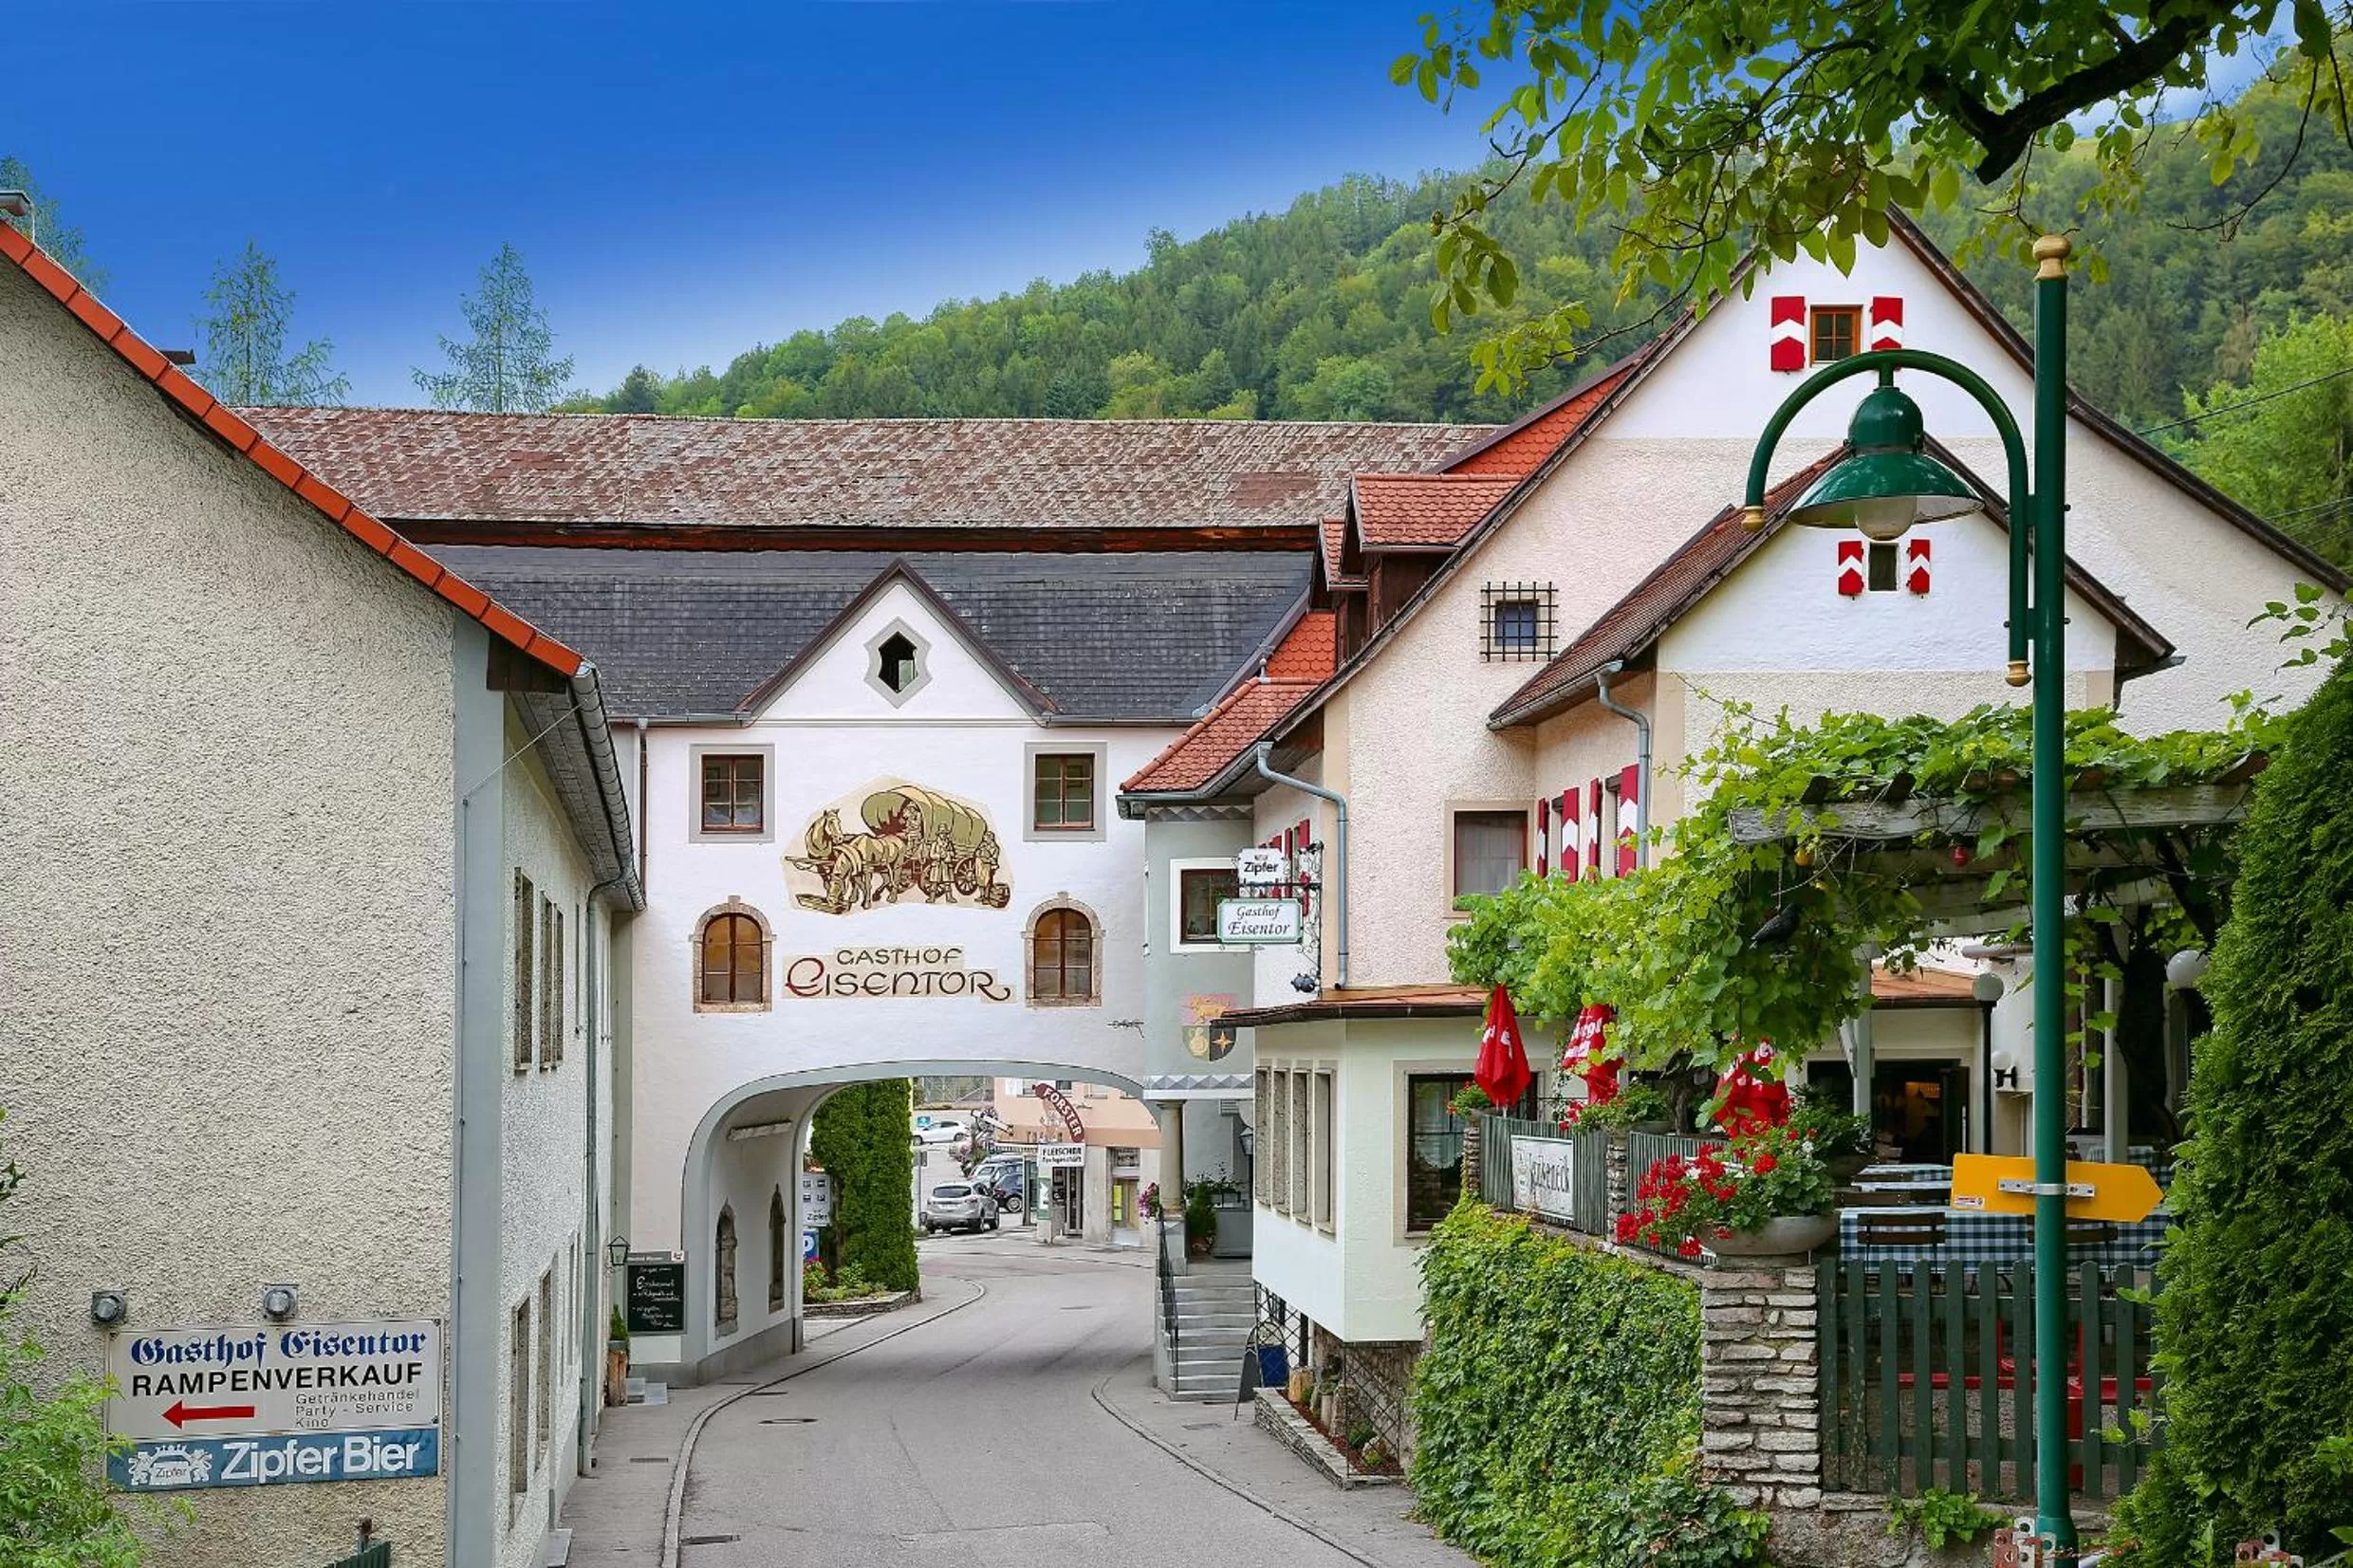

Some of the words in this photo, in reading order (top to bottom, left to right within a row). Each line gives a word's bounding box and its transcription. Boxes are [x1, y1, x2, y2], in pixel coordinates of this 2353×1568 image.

[1244, 861, 1279, 876] Zipfer
[1237, 905, 1281, 920] Gasthof
[1228, 921, 1290, 935] Eisentor
[837, 949, 962, 965] GASTHOF
[1044, 1087, 1082, 1136] FORSTER
[1043, 1147, 1082, 1156] FLEISCHER
[131, 1333, 268, 1369] Gasthof
[281, 1329, 427, 1358] Eisentor
[133, 1362, 423, 1396] RAMPENVERKAUF
[296, 1388, 419, 1404] Getränkehandel
[296, 1404, 336, 1418] Party
[355, 1402, 414, 1413] Service
[295, 1417, 329, 1428] Kino
[221, 1440, 338, 1484] Zipfer
[343, 1435, 419, 1473] Bier
[155, 1466, 188, 1480] Zipfer
